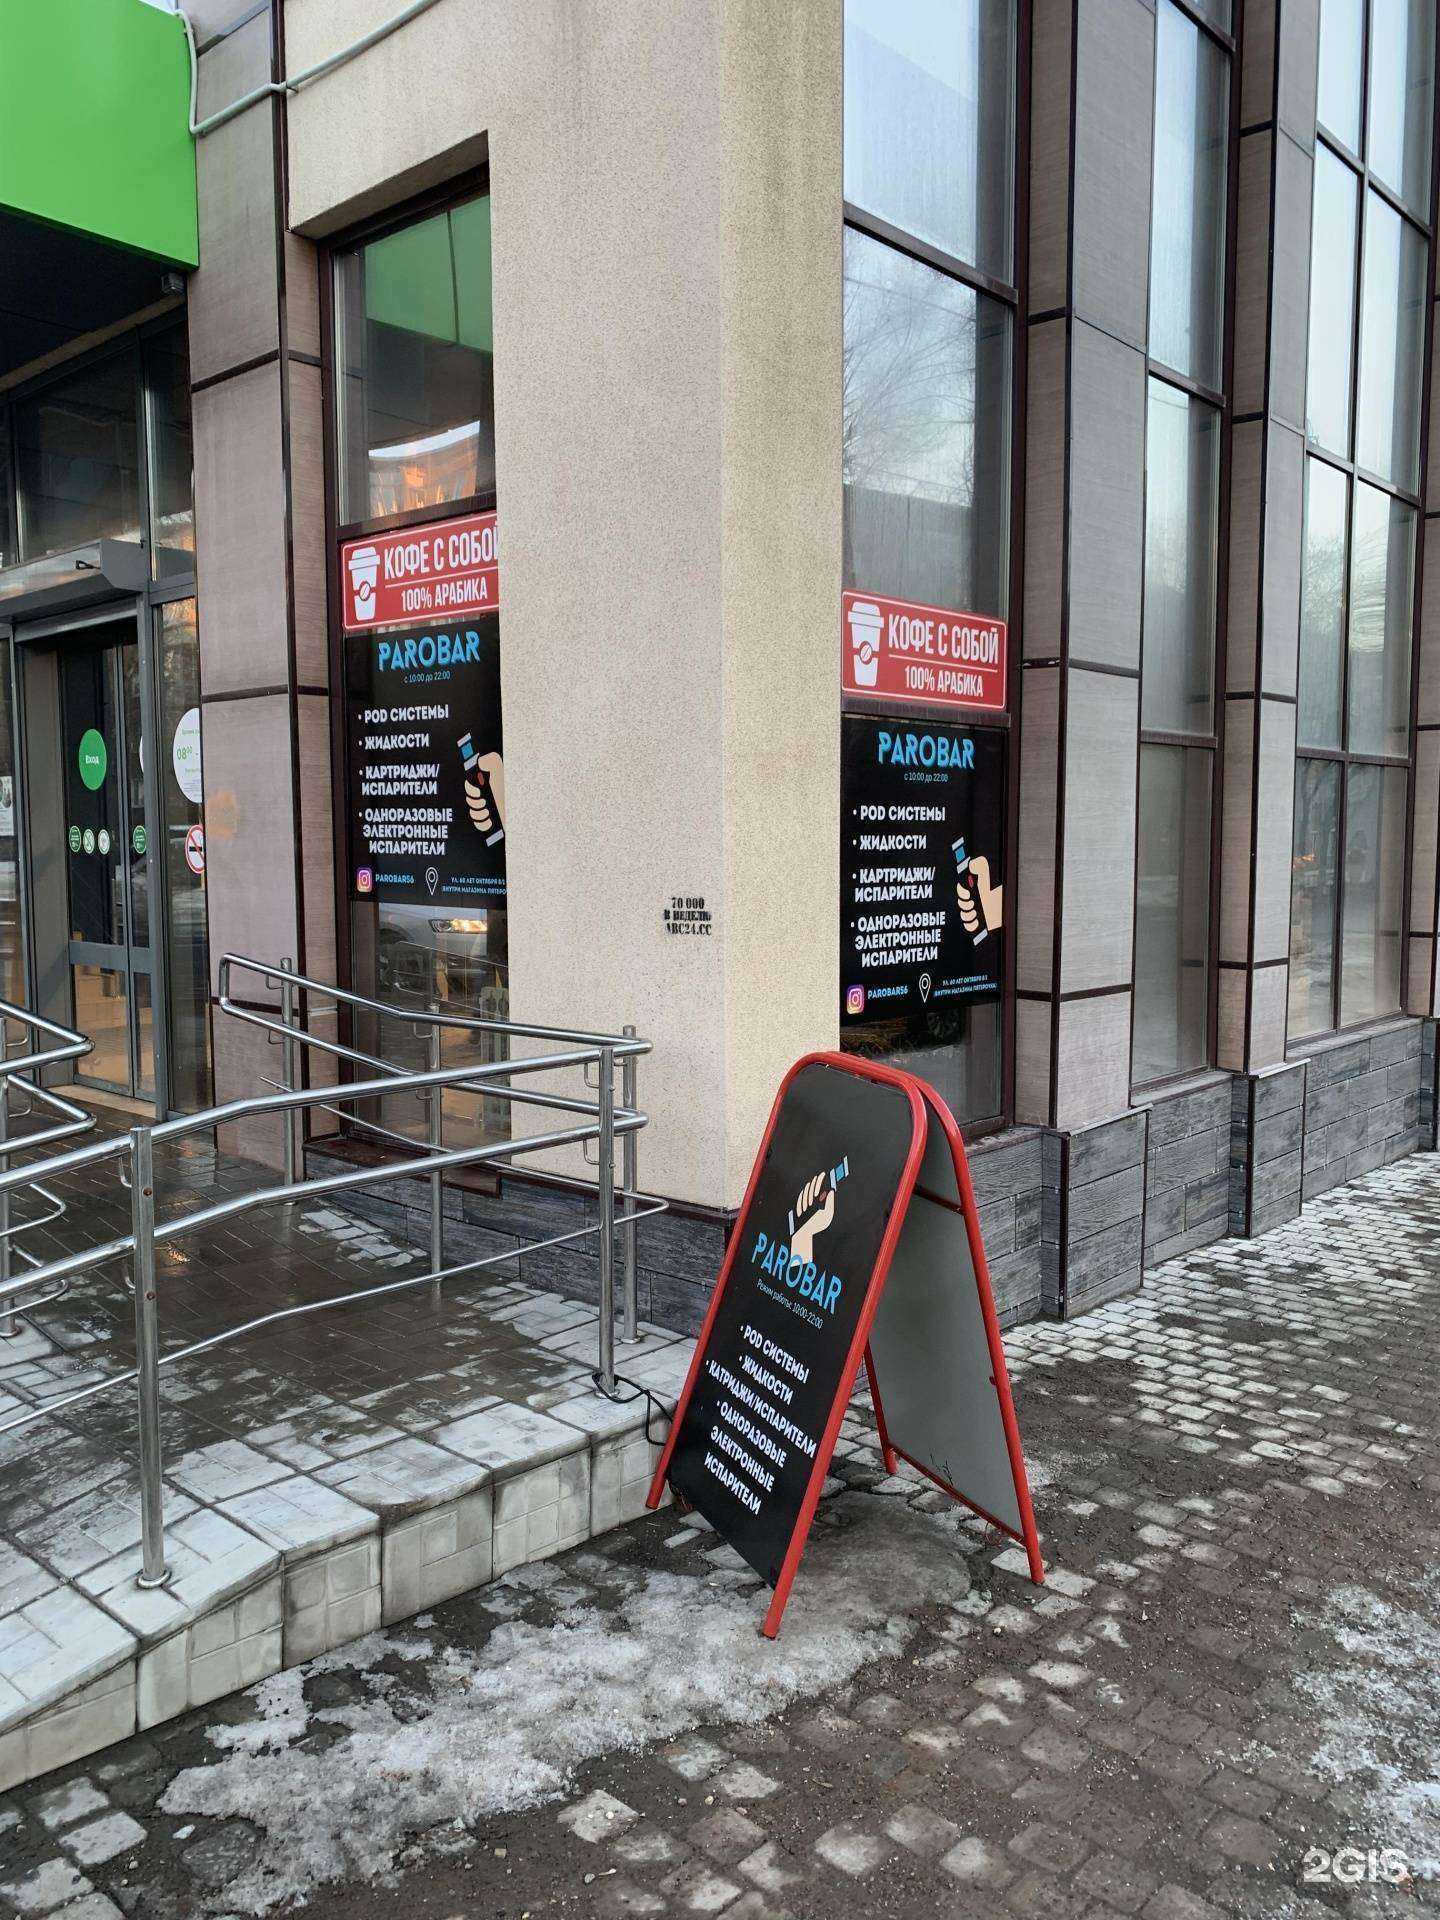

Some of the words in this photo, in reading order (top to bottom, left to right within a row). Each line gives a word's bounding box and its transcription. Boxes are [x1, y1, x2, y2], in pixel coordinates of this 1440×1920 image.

[385, 540, 430, 580] КОФЕ
[434, 537, 444, 571] С
[401, 586, 432, 612] 100%
[435, 576, 488, 607] АРАБИКА
[888, 613, 935, 654] КОФЕ
[938, 622, 948, 656] С
[951, 625, 999, 665] СОБОЙ
[378, 631, 481, 672] PAROBAR
[904, 665, 935, 691] 100%
[937, 670, 984, 698] АРАБИКА
[364, 708, 388, 724] POD
[390, 704, 449, 722] СИСТЕМЫ
[364, 733, 430, 750] ЖИДКОСТИ
[878, 731, 975, 769] PAROBAR
[365, 763, 440, 780] КАРТРИДЖИ/
[361, 780, 438, 796] ИСПАРИТЕЛИ
[364, 808, 453, 823] ОДНОРАЗОВЫЕ
[860, 805, 886, 821] POD
[888, 806, 946, 821] СИСТЕМЫ
[362, 824, 449, 839] ЭЛЕКТРОННЫЕ
[369, 840, 446, 855] ИСПАРИТЕЛИ
[859, 835, 927, 851] ЖИДКОСТИ
[859, 866, 936, 884] КАРТРИДЖИ/
[854, 884, 933, 903] ИСПАРИТЕЛИ
[857, 911, 946, 933] ОДНОРАЗОВЫЕ
[854, 928, 942, 951] ЭЛЕКТРОННЫЕ
[861, 946, 939, 968] ИСПАРИТЕЛИ
[867, 984, 909, 1000] PAROBAR56
[751, 1232, 842, 1315] PAROBAR
[757, 1278, 774, 1297] Режим
[743, 1325, 763, 1349] POD
[762, 1339, 810, 1384] СИСТЕМЫ
[741, 1355, 794, 1405] ЖИДКОСТИ
[720, 1401, 787, 1468] ОДНОРАЗОВЫЕ
[710, 1425, 775, 1493] ЭЛЕКТРОННЫЕ
[704, 1452, 762, 1516] ИСПАРИТЕЛИ
